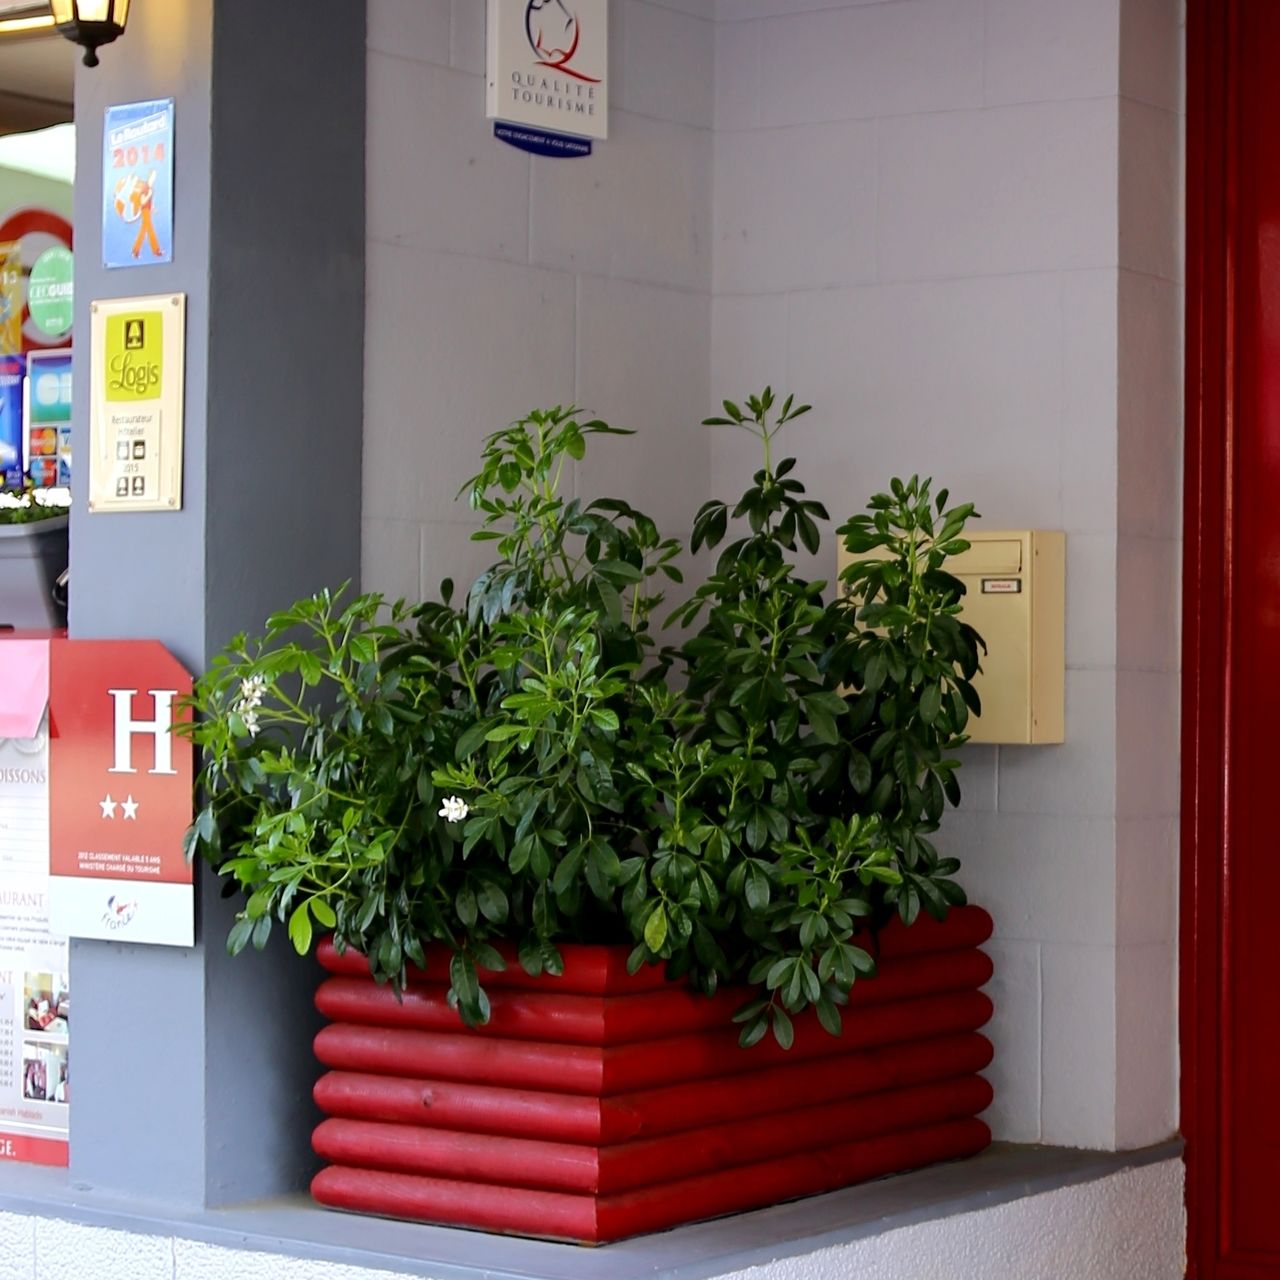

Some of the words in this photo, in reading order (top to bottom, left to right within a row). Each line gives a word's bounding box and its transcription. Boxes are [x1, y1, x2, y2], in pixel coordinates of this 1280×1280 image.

[511, 87, 595, 116] TOURISME
[113, 143, 165, 168] 2014
[109, 351, 159, 395] Logis
[107, 688, 178, 774] H
